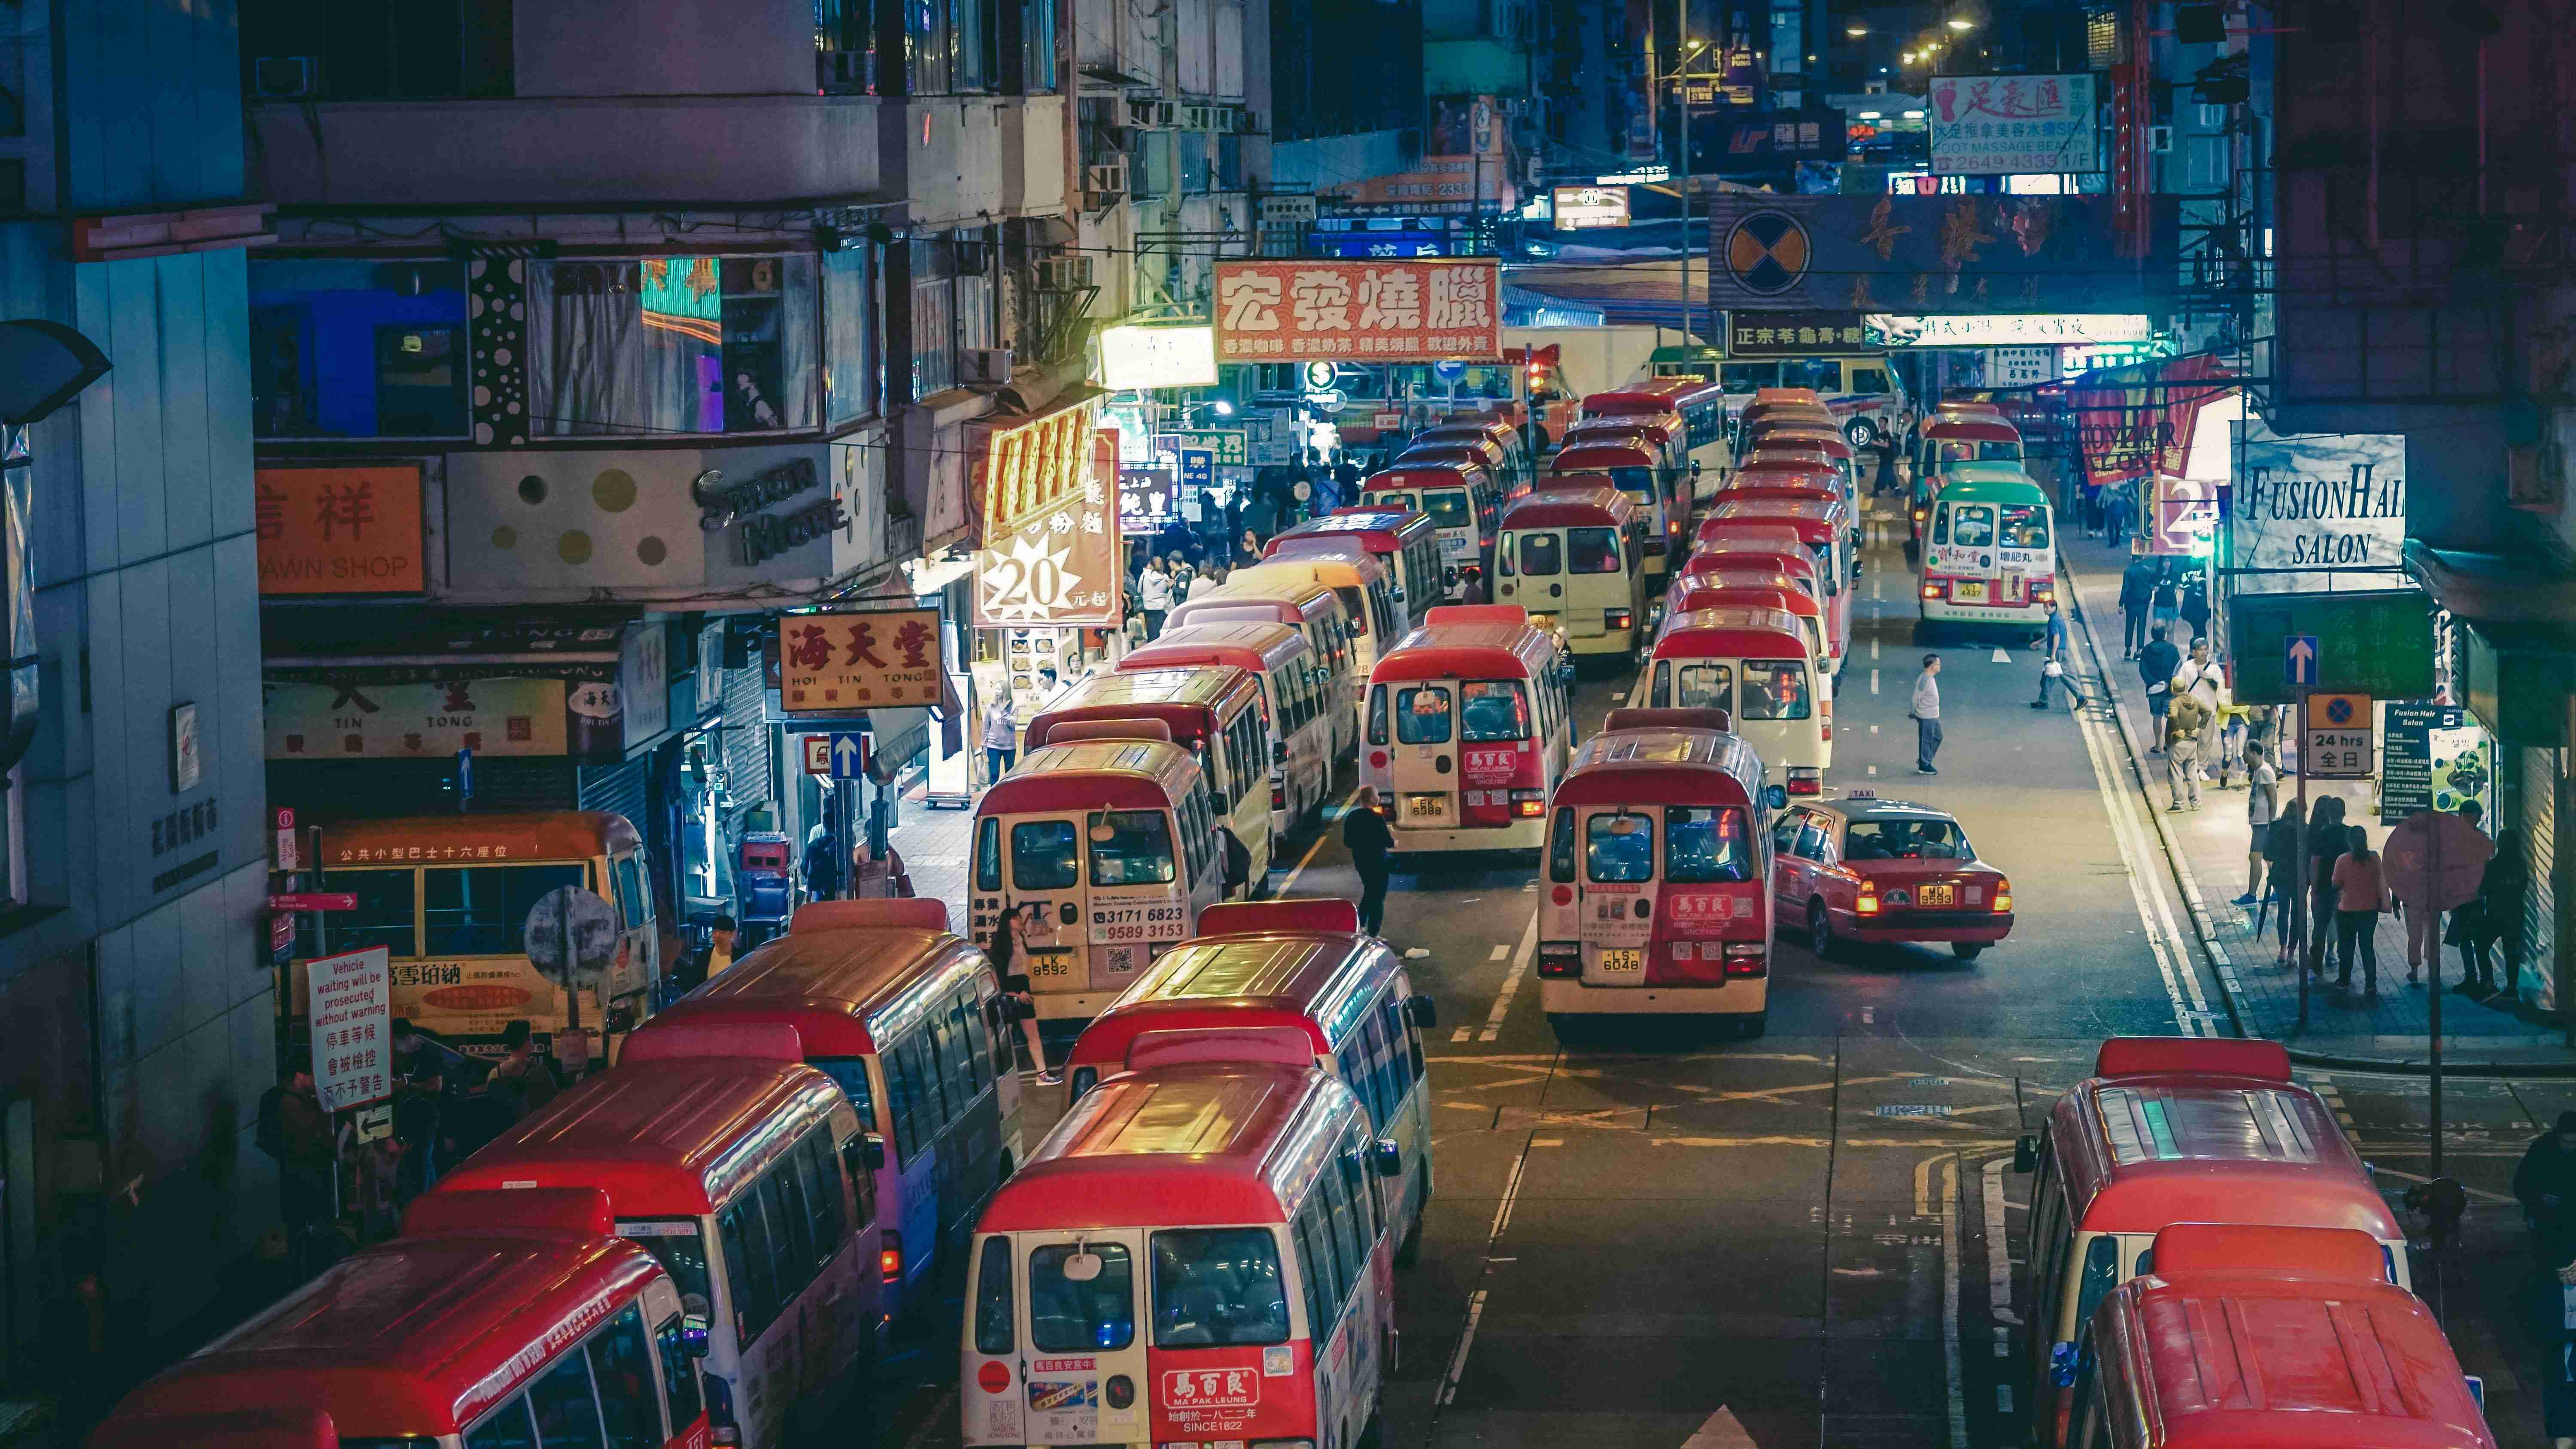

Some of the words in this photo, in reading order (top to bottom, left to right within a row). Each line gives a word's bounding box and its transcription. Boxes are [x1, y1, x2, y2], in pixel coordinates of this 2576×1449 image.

[1972, 142, 2034, 153] MASSAGE
[2038, 140, 2088, 151] BEAUTY
[1957, 154, 2004, 170] 2649
[1224, 339, 1284, 354] 香濃咖啡
[1292, 338, 1352, 354] 香濃奶茶
[1427, 337, 1487, 352] 歡迎外賣
[2000, 551, 2032, 563] 增肥丸
[2292, 534, 2372, 564] SALON
[259, 558, 323, 579] AWN
[331, 556, 409, 579] SHOP
[999, 558, 1060, 606] 20
[1073, 591, 1107, 607] 元起
[788, 620, 936, 671] 海天堂
[792, 677, 817, 686] HOI
[838, 676, 862, 684] TIN
[883, 673, 923, 683] TONG
[334, 718, 362, 728] TIN
[426, 717, 474, 728] TONG
[2315, 734, 2336, 746] 24
[2340, 734, 2363, 746] hrs
[2320, 750, 2358, 768] 全日
[340, 845, 507, 861] 公共小型巴士十六座位
[1929, 887, 1944, 895] MD
[1678, 896, 1725, 912] 馬百良
[1921, 895, 1952, 904] 9593
[1106, 910, 1142, 923] 3171
[1147, 908, 1183, 921] 6823
[1108, 926, 1144, 940] 9589
[1148, 924, 1184, 938] 3153
[1041, 956, 1058, 966] LK
[1613, 951, 1630, 961] LS
[333, 958, 365, 975] Vehicle
[1033, 966, 1068, 976] 8592
[1604, 960, 1639, 970] 6048
[317, 979, 349, 995] waiting
[351, 974, 368, 988] will
[370, 971, 381, 982] be
[324, 988, 375, 1010] prosecuted
[315, 1012, 348, 1028] without
[351, 1003, 386, 1020] warning
[326, 1024, 376, 1051] 停車等候
[327, 1049, 376, 1077] 會被檢控
[324, 1073, 383, 1104] 而不予警告
[1174, 1371, 1246, 1398] 馬百良
[1168, 1408, 1258, 1422] 始創於一八二二年
[1183, 1421, 1242, 1433] SINCE1822
